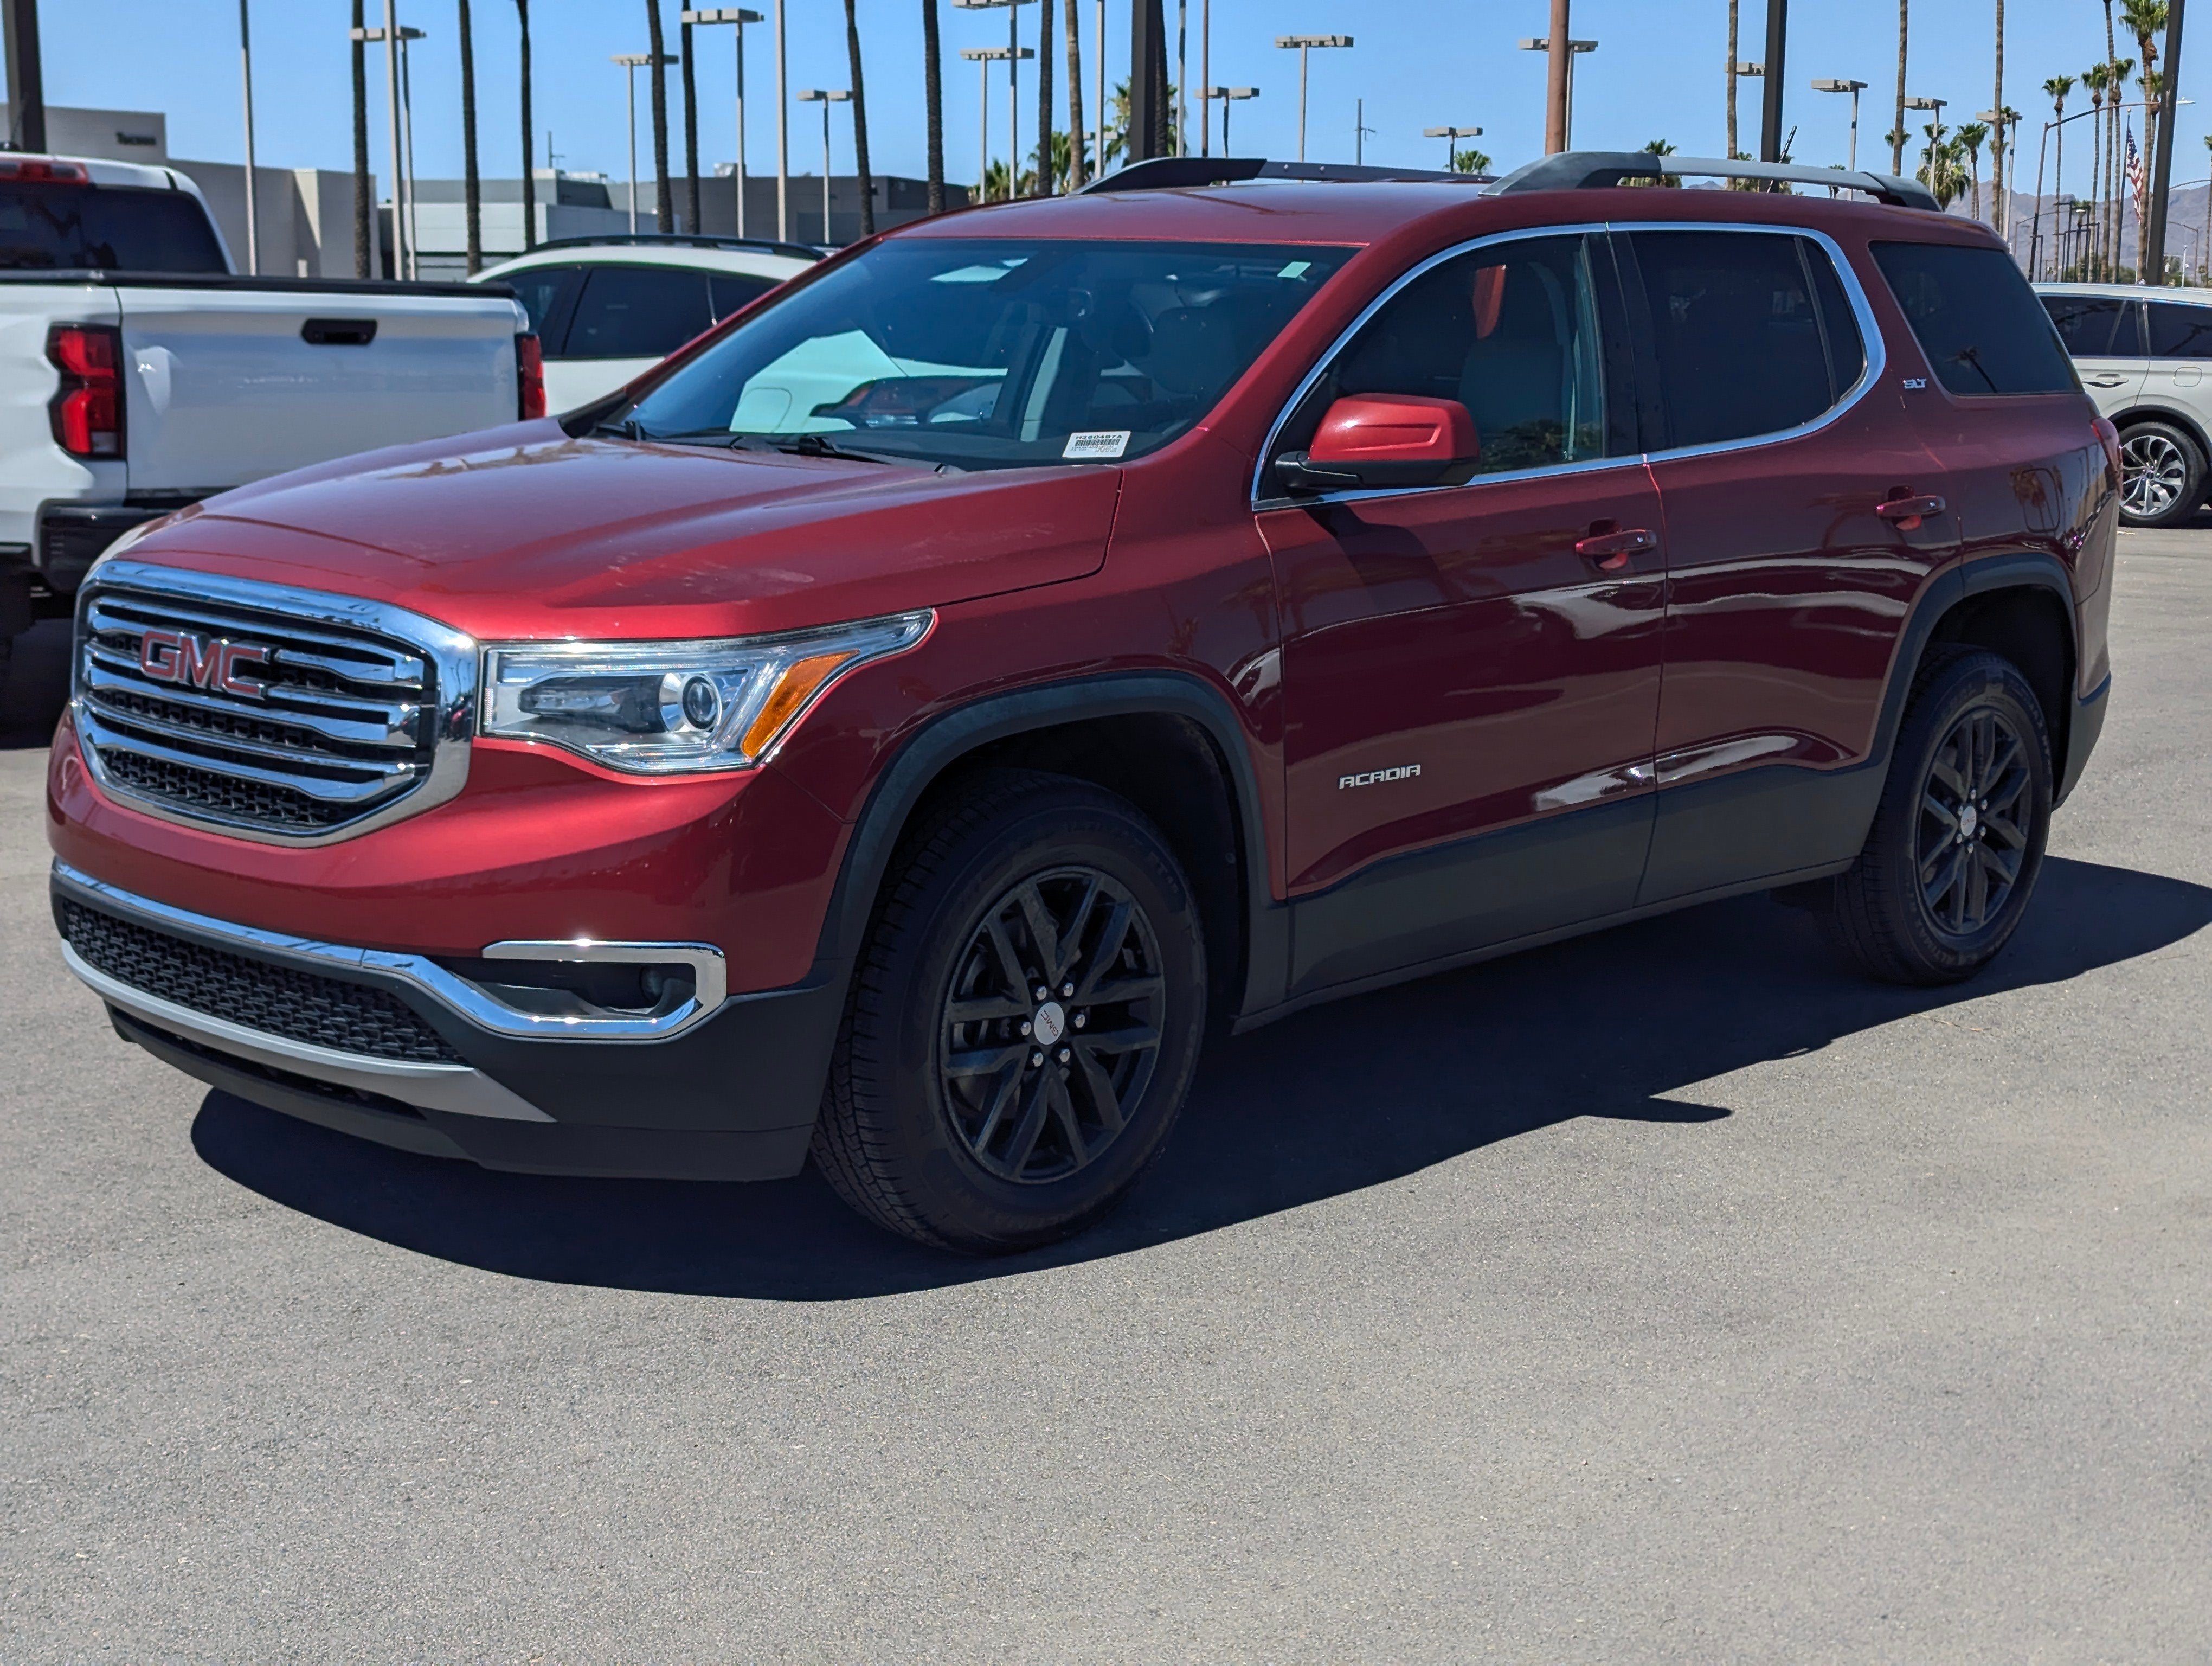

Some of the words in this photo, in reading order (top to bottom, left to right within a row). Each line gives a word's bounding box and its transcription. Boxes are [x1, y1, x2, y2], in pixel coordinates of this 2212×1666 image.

[1902, 378, 1927, 389] SLT
[141, 630, 267, 700] GMC
[1339, 764, 1421, 789] ACADIA
[1040, 1010, 1059, 1037] GMC
